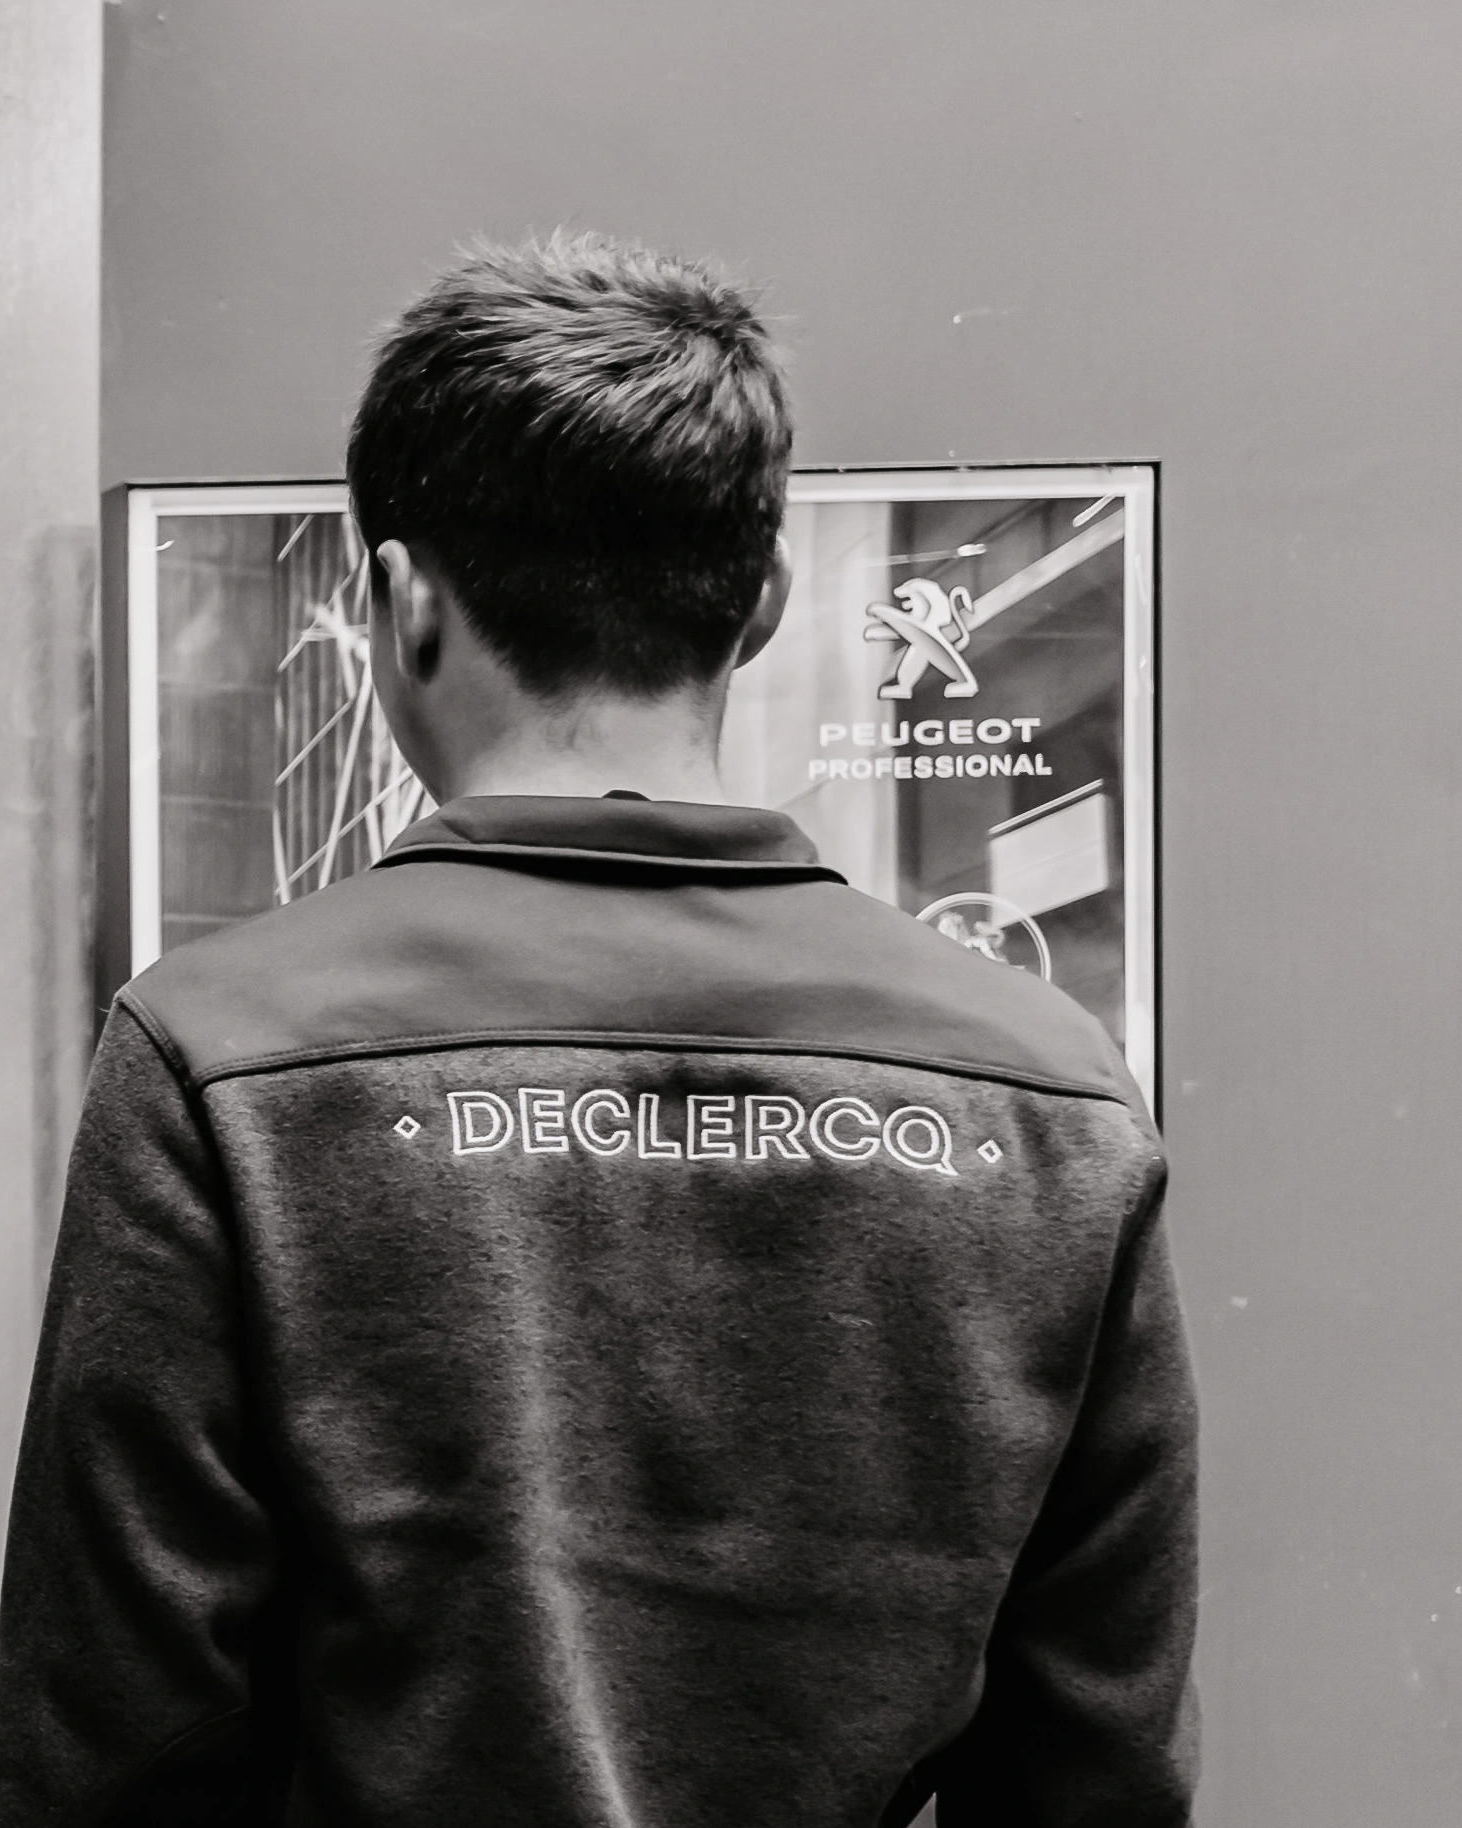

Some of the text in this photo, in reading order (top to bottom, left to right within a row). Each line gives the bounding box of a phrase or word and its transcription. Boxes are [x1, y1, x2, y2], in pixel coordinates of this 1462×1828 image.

[819, 718, 1041, 747] PEUGEOT
[808, 753, 1053, 781] PROFESSIONAL
[448, 1088, 958, 1176] DECLERCQ
